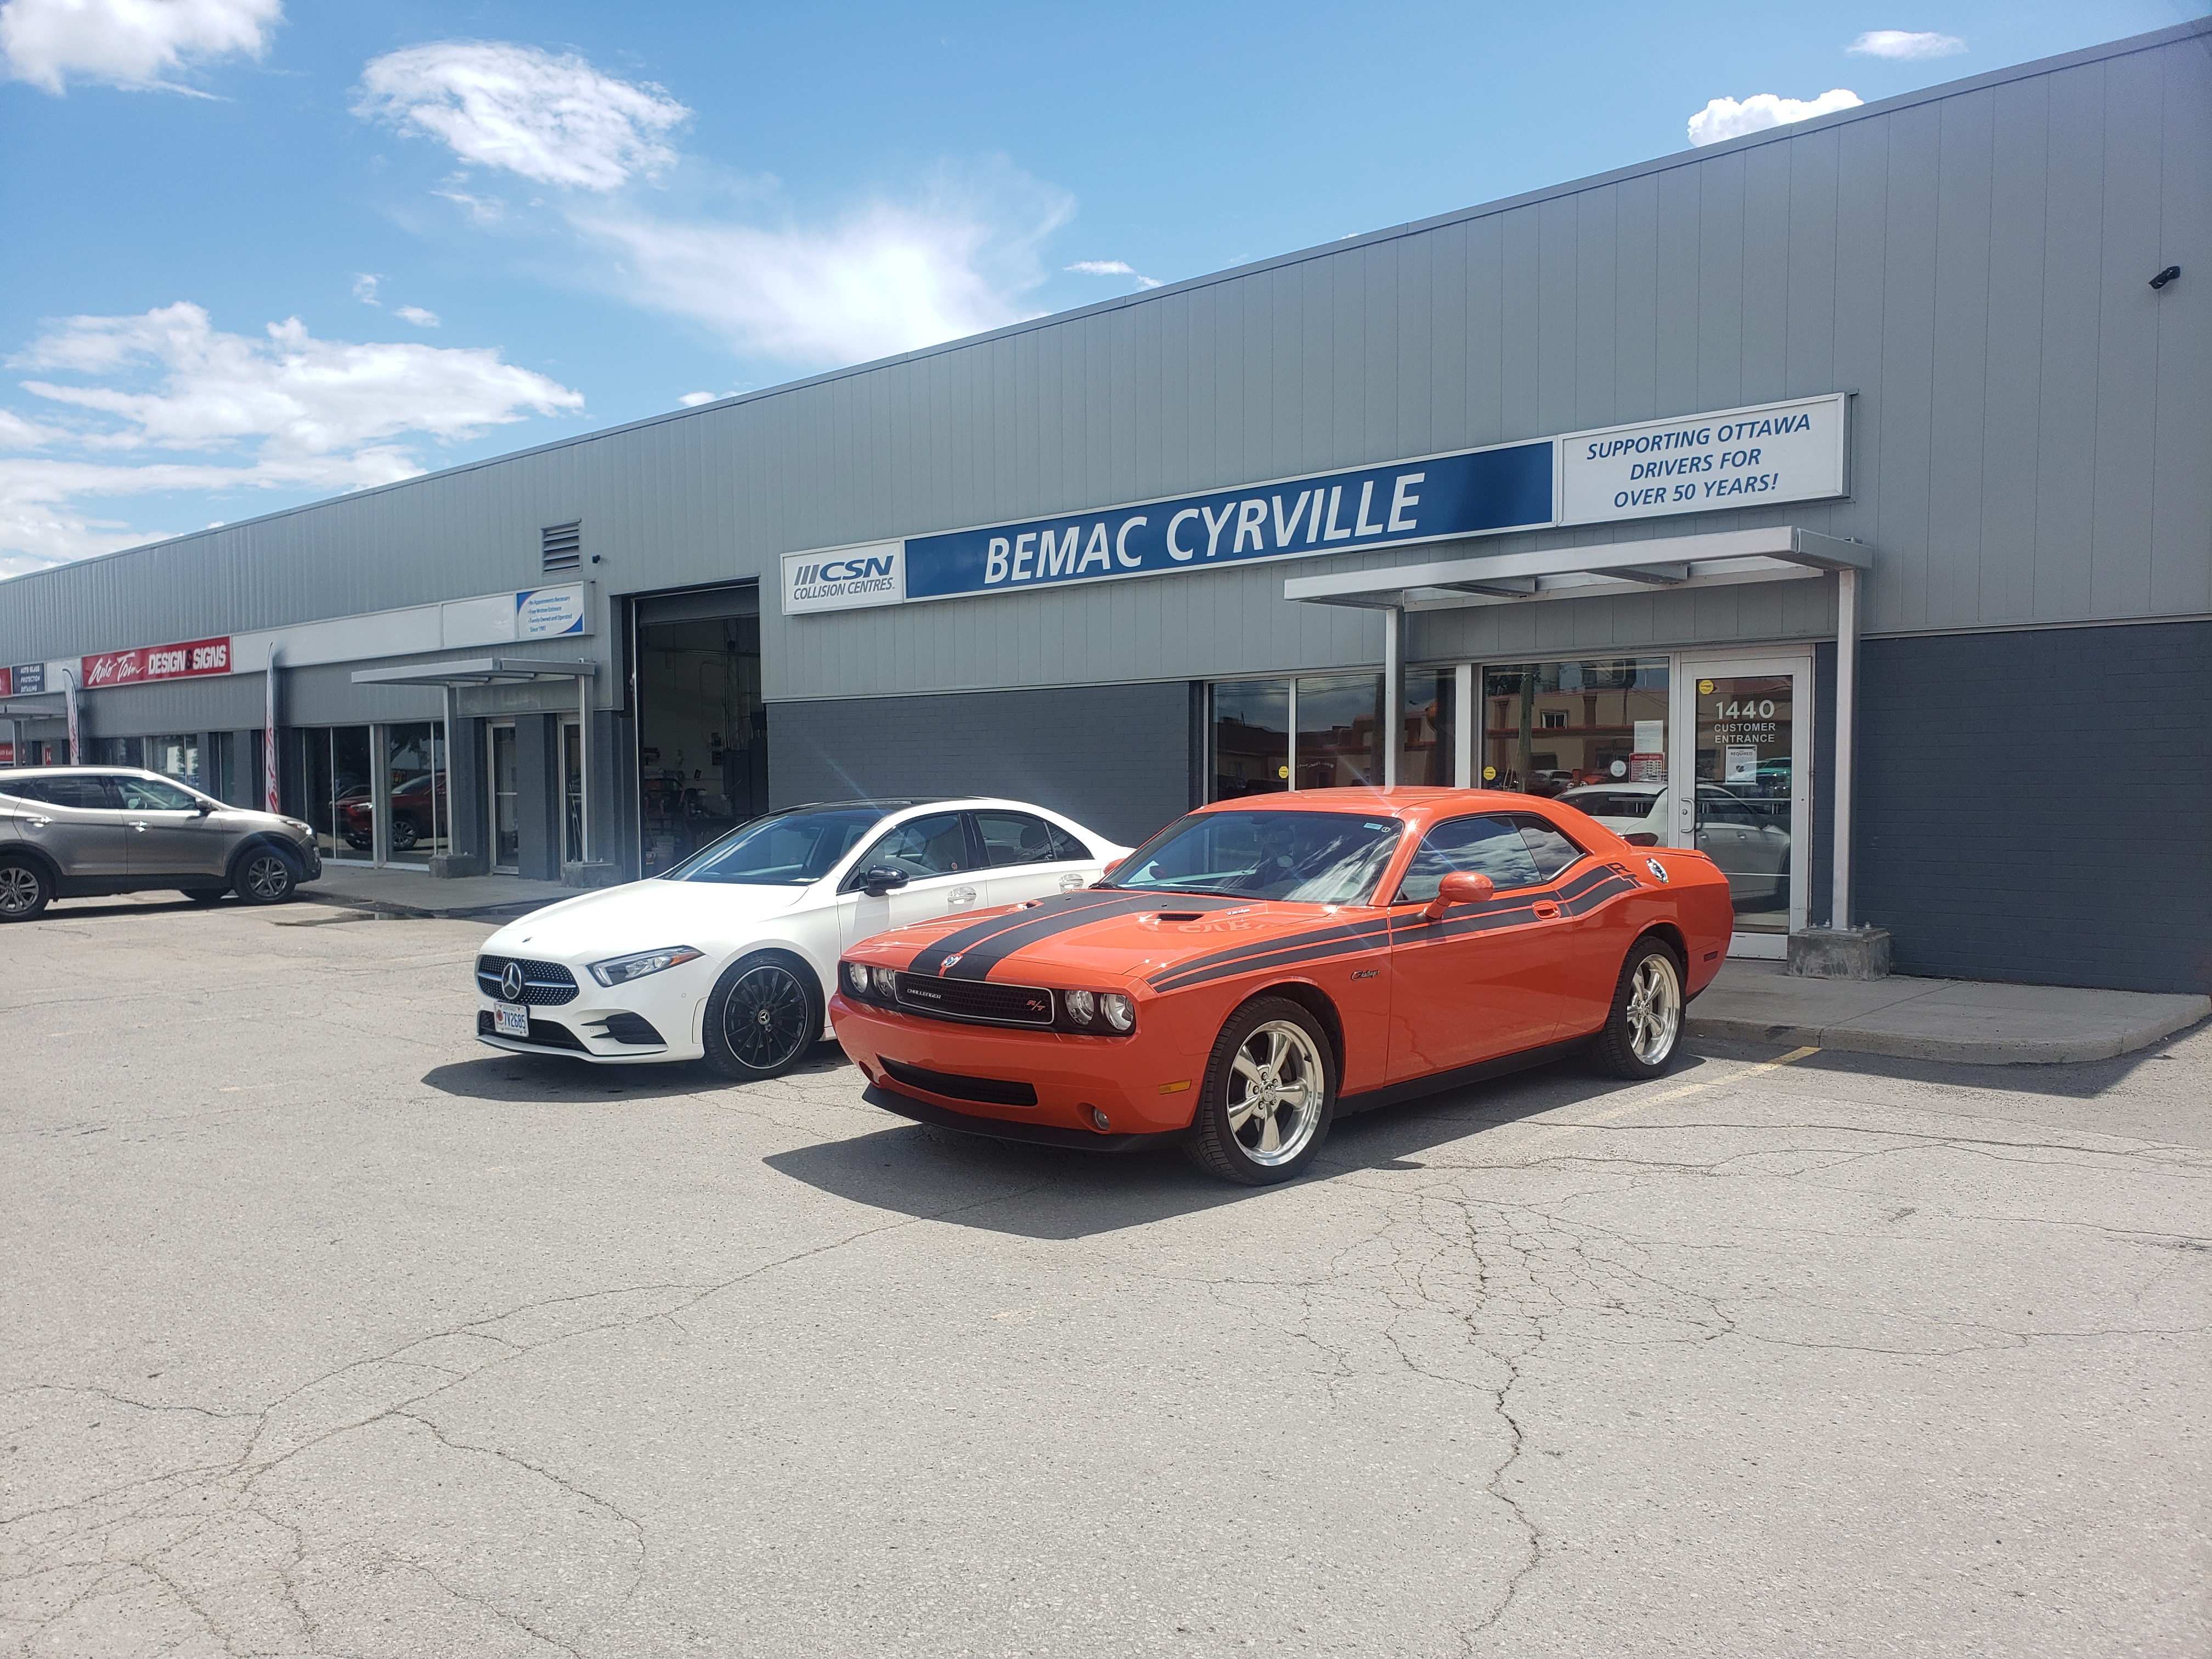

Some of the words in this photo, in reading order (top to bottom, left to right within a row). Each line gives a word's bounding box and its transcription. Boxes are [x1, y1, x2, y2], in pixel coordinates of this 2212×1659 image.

[1587, 428, 1711, 460] SUPPORTING
[1717, 414, 1810, 442] OTTAWA
[1630, 454, 1712, 481] DRIVERS
[1719, 449, 1762, 469] FOR
[1614, 487, 1667, 507] OVER
[1673, 483, 1696, 501] 50
[1703, 473, 1779, 498] YEARS!
[984, 517, 1147, 584] BEMAC
[1166, 472, 1425, 561] CYRVILLE
[820, 555, 894, 582] CSN
[794, 583, 846, 600] COLLISION
[848, 577, 893, 594] CENTRES
[88, 658, 117, 685] Auto
[148, 650, 186, 675] DESIGN
[193, 645, 226, 670] SIGNS
[1716, 699, 1775, 719] 1440
[1714, 723, 1775, 732] CUSTOMER
[1715, 734, 1775, 743] ENTRANCE
[907, 989, 941, 999] CHALLENGER
[1026, 1000, 1046, 1011] R/T
